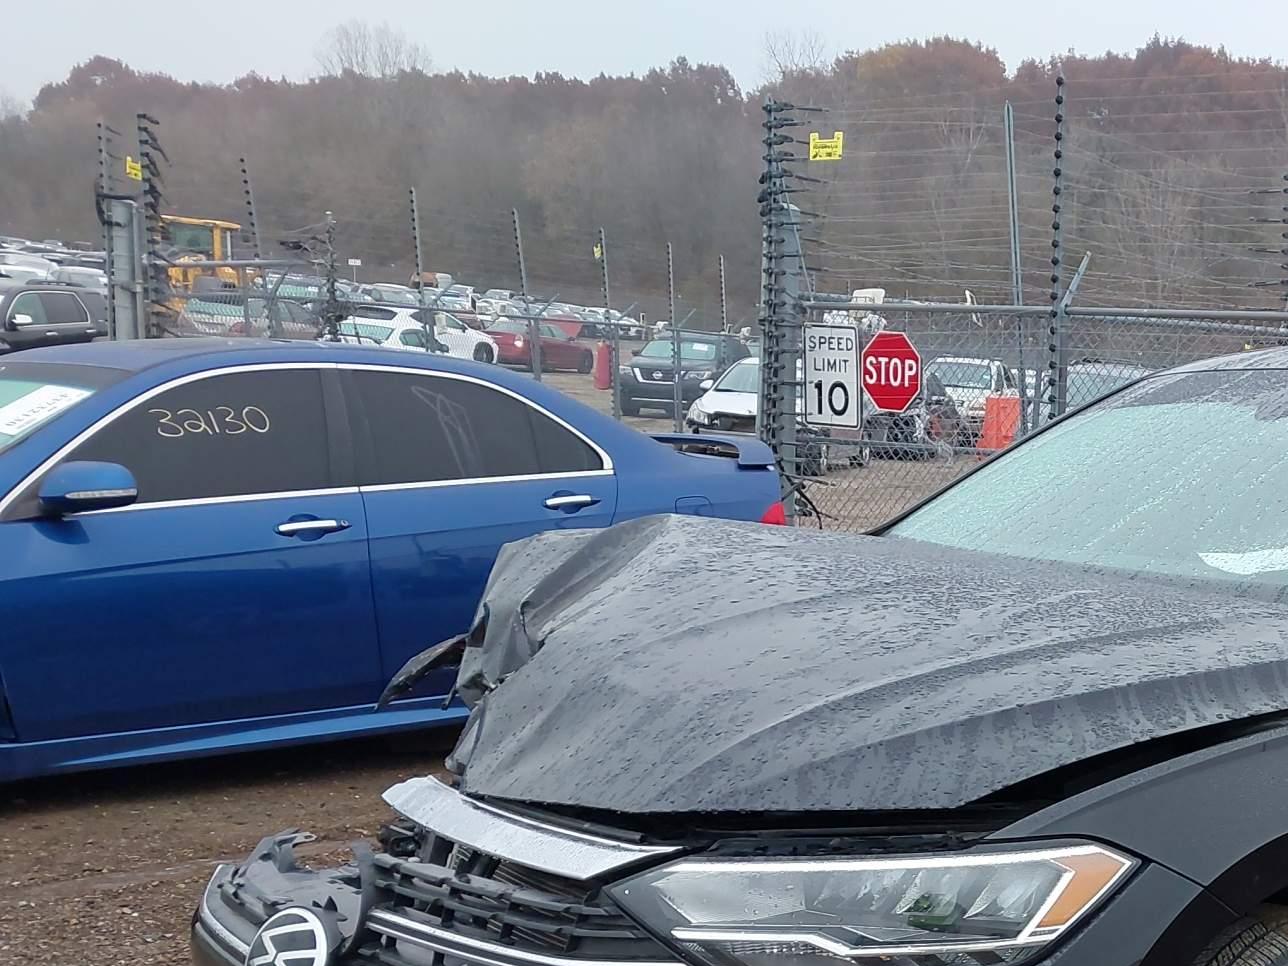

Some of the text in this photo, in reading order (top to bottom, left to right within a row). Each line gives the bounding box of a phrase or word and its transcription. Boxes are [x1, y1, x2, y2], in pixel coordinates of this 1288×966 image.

[808, 335, 854, 352] SPEED
[813, 356, 850, 374] LIMIT
[865, 355, 917, 388] STOP
[814, 380, 850, 417] 10
[148, 406, 270, 437] 32130
